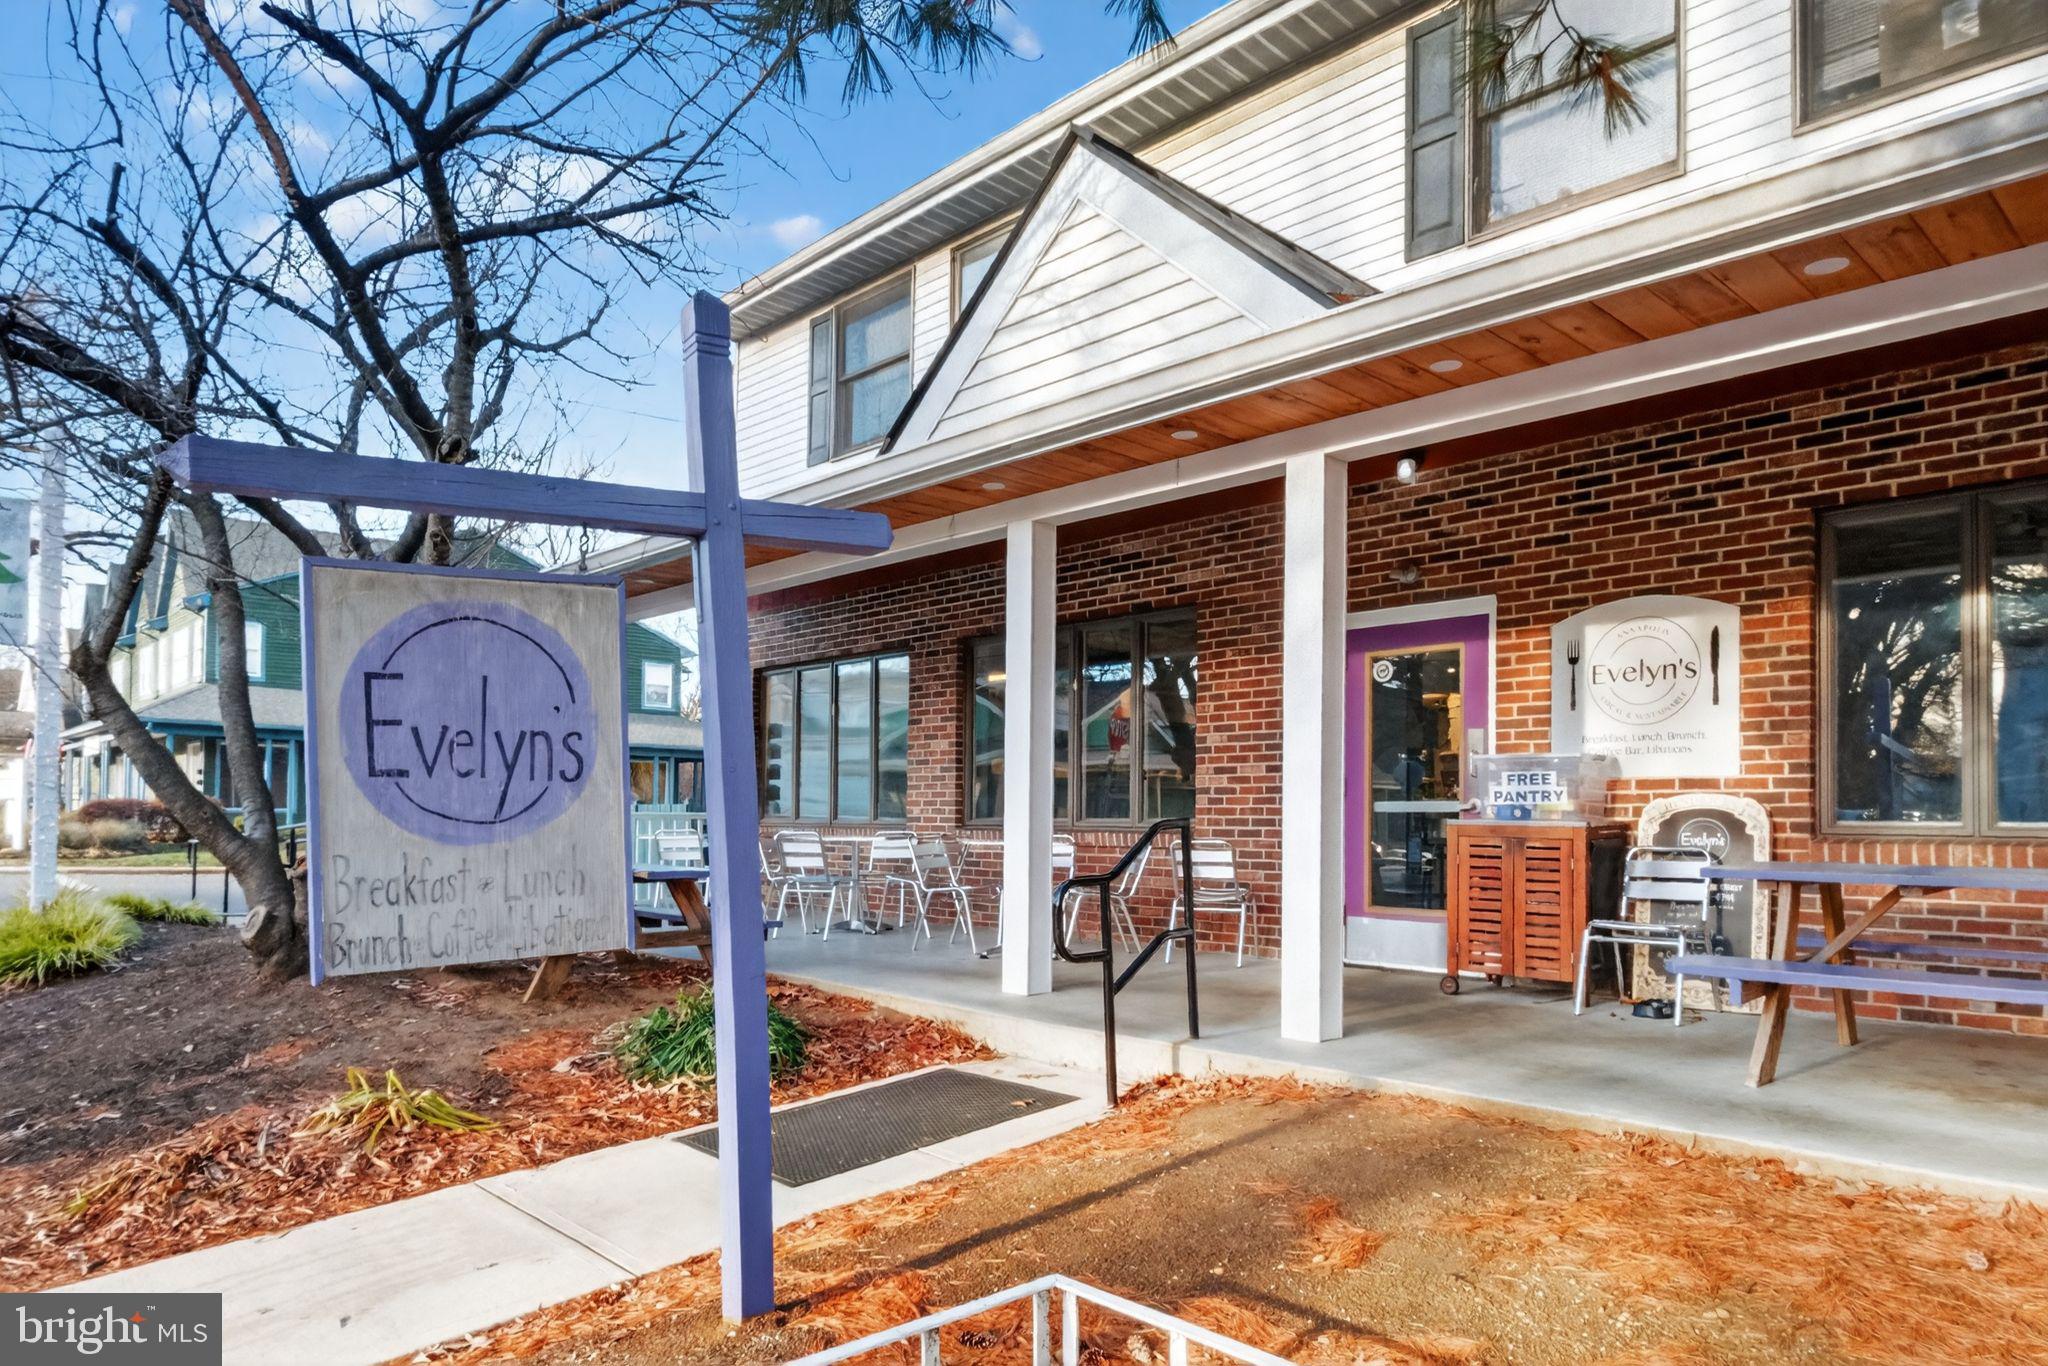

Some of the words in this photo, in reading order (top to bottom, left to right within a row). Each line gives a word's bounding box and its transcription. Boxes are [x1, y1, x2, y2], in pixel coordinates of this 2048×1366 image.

[1592, 658, 1697, 687] Evelyn's
[363, 671, 585, 819] Evelyn's
[1507, 773, 1552, 786] FREE
[1494, 790, 1564, 803] PANTRY
[1681, 832, 1726, 852] Evelyn's
[332, 852, 471, 914] Breakfast
[504, 844, 587, 903] Lunch
[328, 914, 413, 969] Brunch
[427, 908, 495, 959] Coffee
